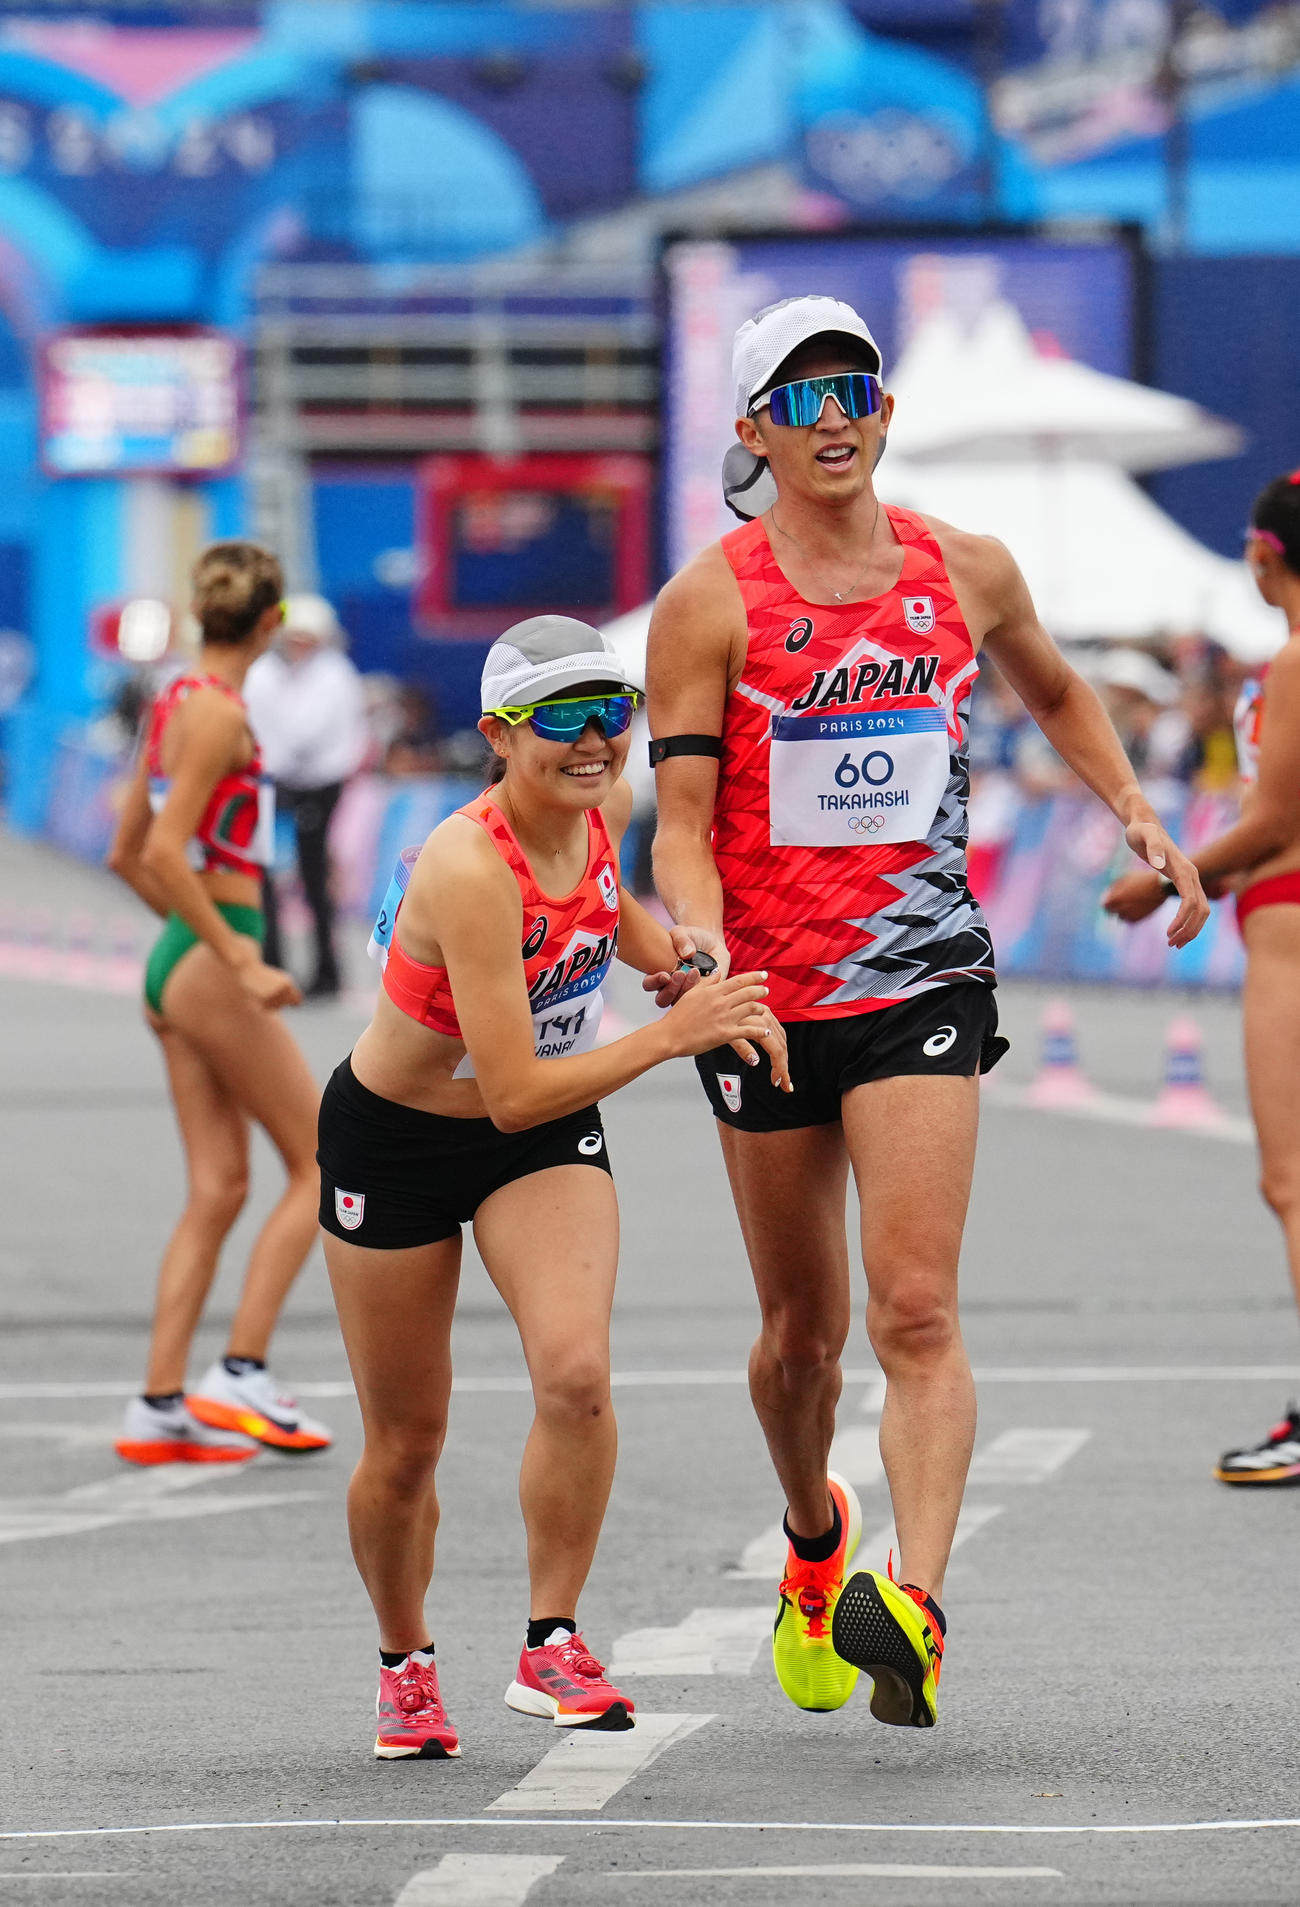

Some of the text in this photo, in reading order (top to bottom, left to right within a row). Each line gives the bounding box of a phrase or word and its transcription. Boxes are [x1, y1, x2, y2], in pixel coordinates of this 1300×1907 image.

[791, 656, 940, 711] JAPAN
[820, 717, 904, 734] PARIS 2024
[834, 750, 894, 788] 60
[817, 789, 909, 811] TAKAHASHI
[536, 973, 602, 1010] PARIS 2024
